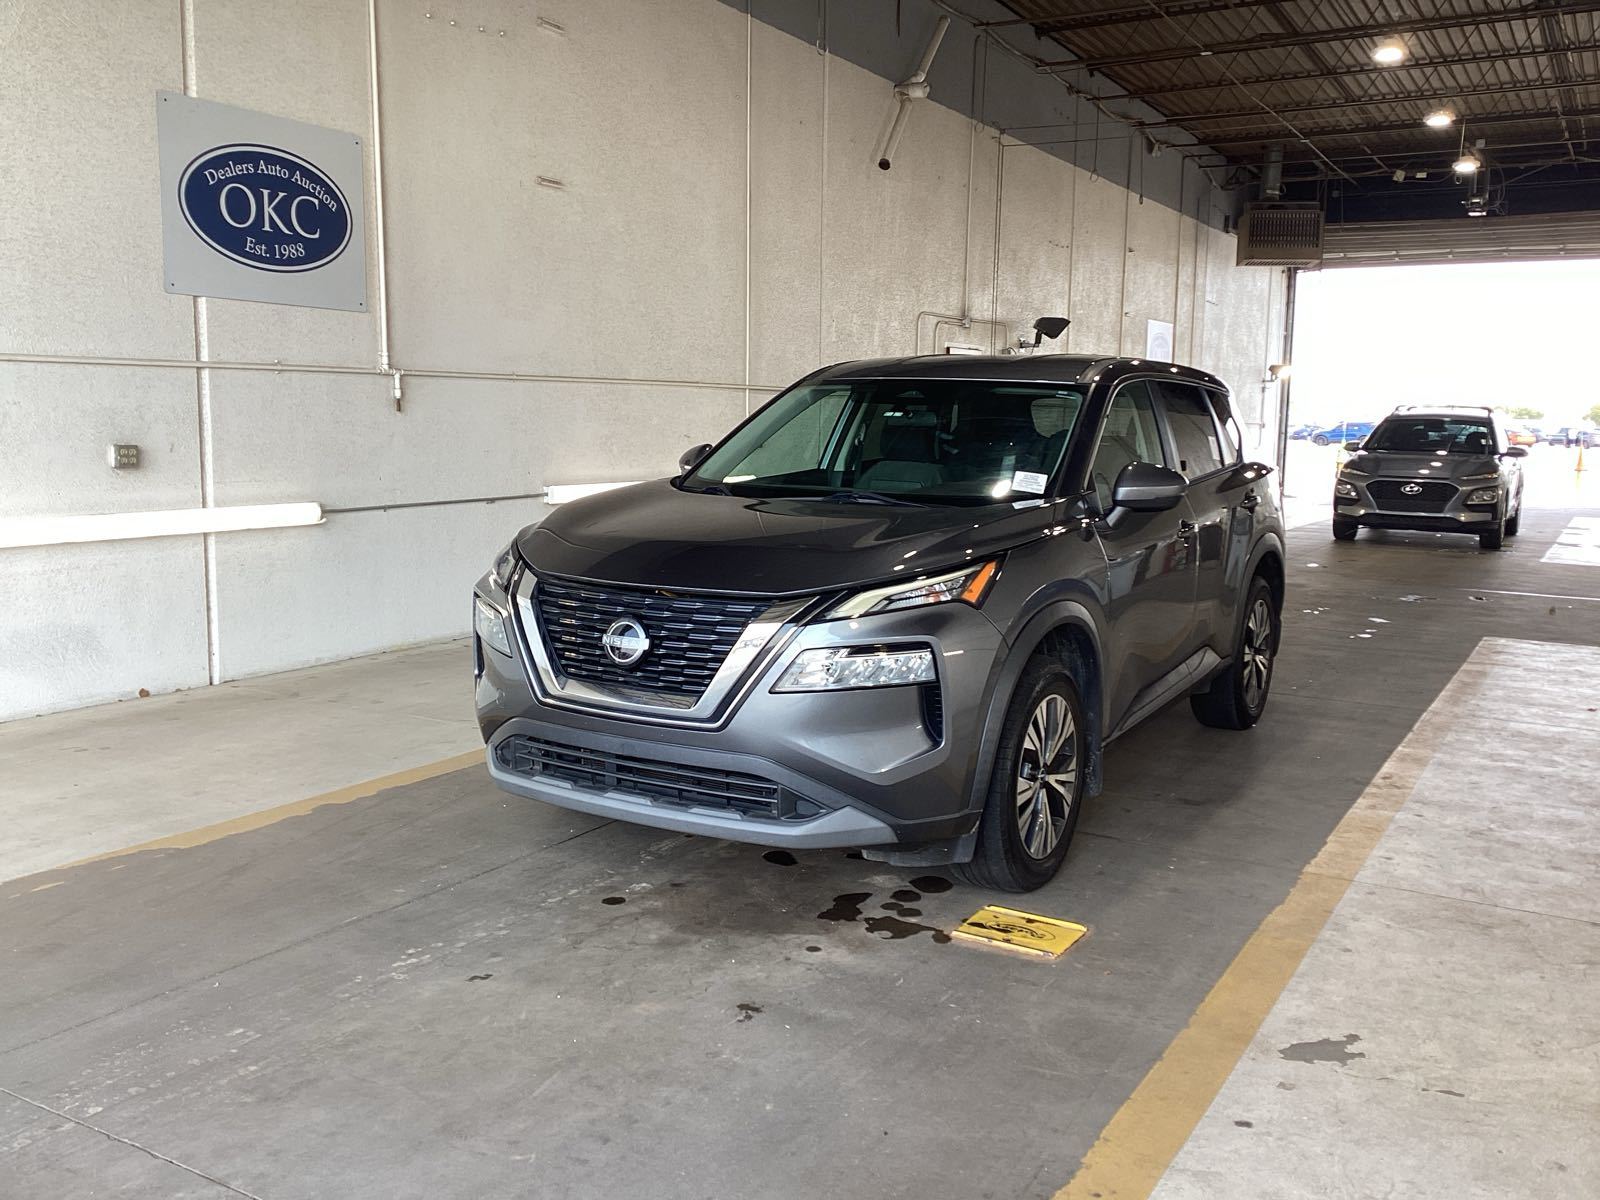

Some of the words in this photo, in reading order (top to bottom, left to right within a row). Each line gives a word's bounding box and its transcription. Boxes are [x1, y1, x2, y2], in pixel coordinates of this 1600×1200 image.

[203, 161, 254, 186] Dealers
[257, 160, 289, 179] Auto
[291, 170, 338, 212] Auction
[219, 183, 320, 239] OKC
[244, 236, 270, 257] Est.
[274, 242, 305, 259] 1988
[603, 635, 647, 648] NISSA
